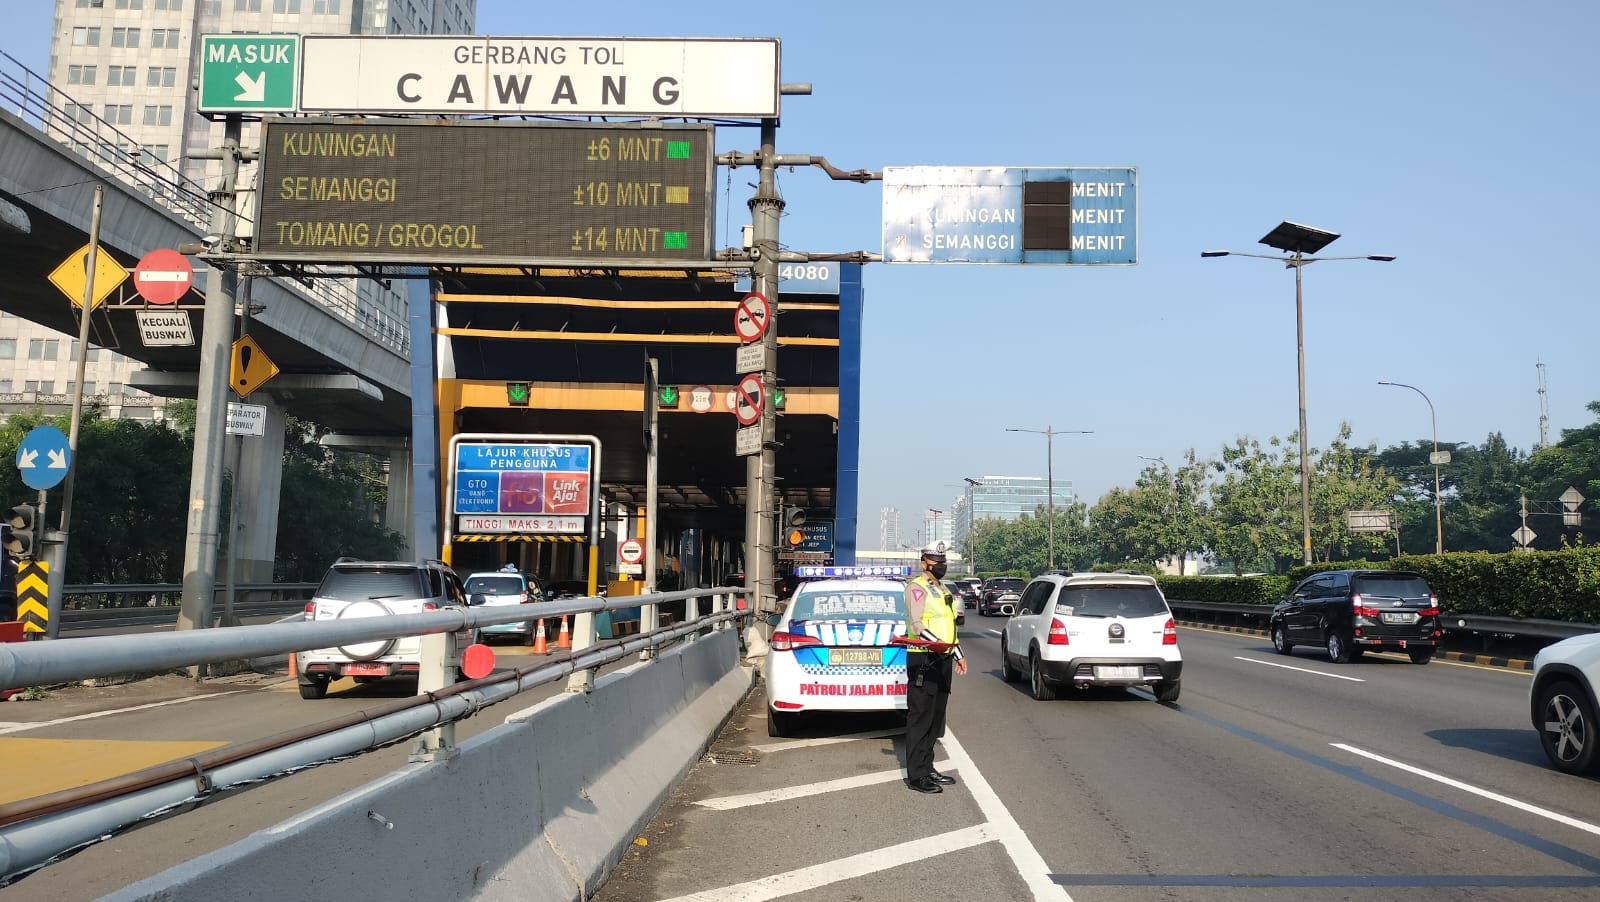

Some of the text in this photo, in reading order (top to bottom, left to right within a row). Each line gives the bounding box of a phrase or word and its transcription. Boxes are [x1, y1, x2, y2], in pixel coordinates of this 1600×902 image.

[207, 43, 291, 64] MASUK
[454, 45, 625, 66] GERBANG TOL
[396, 72, 681, 106] CAWANG
[282, 132, 664, 161] KUNINGAN ±6 MNT
[280, 176, 662, 206] SEMANGGI ±10 MNT
[1072, 182, 1126, 198] MENIT
[924, 208, 1126, 225] KUNINGAN MENIT
[276, 221, 661, 252] TOMANG / GROGOL ±14 MNT
[922, 234, 1126, 251] SEMANGGI MENIT
[142, 317, 187, 327] KECUALI
[145, 330, 187, 340] BUSWAY
[226, 420, 255, 430] BUSWAY
[477, 448, 572, 458] LAJUR KHUSUS
[490, 459, 558, 468] PENGGUNA
[468, 479, 488, 489] GTO
[552, 479, 580, 491] Link
[552, 489, 578, 503] Aja!
[466, 519, 502, 529] TINGGI
[800, 683, 847, 696] PATROLI
[849, 684, 884, 697] JALAN
